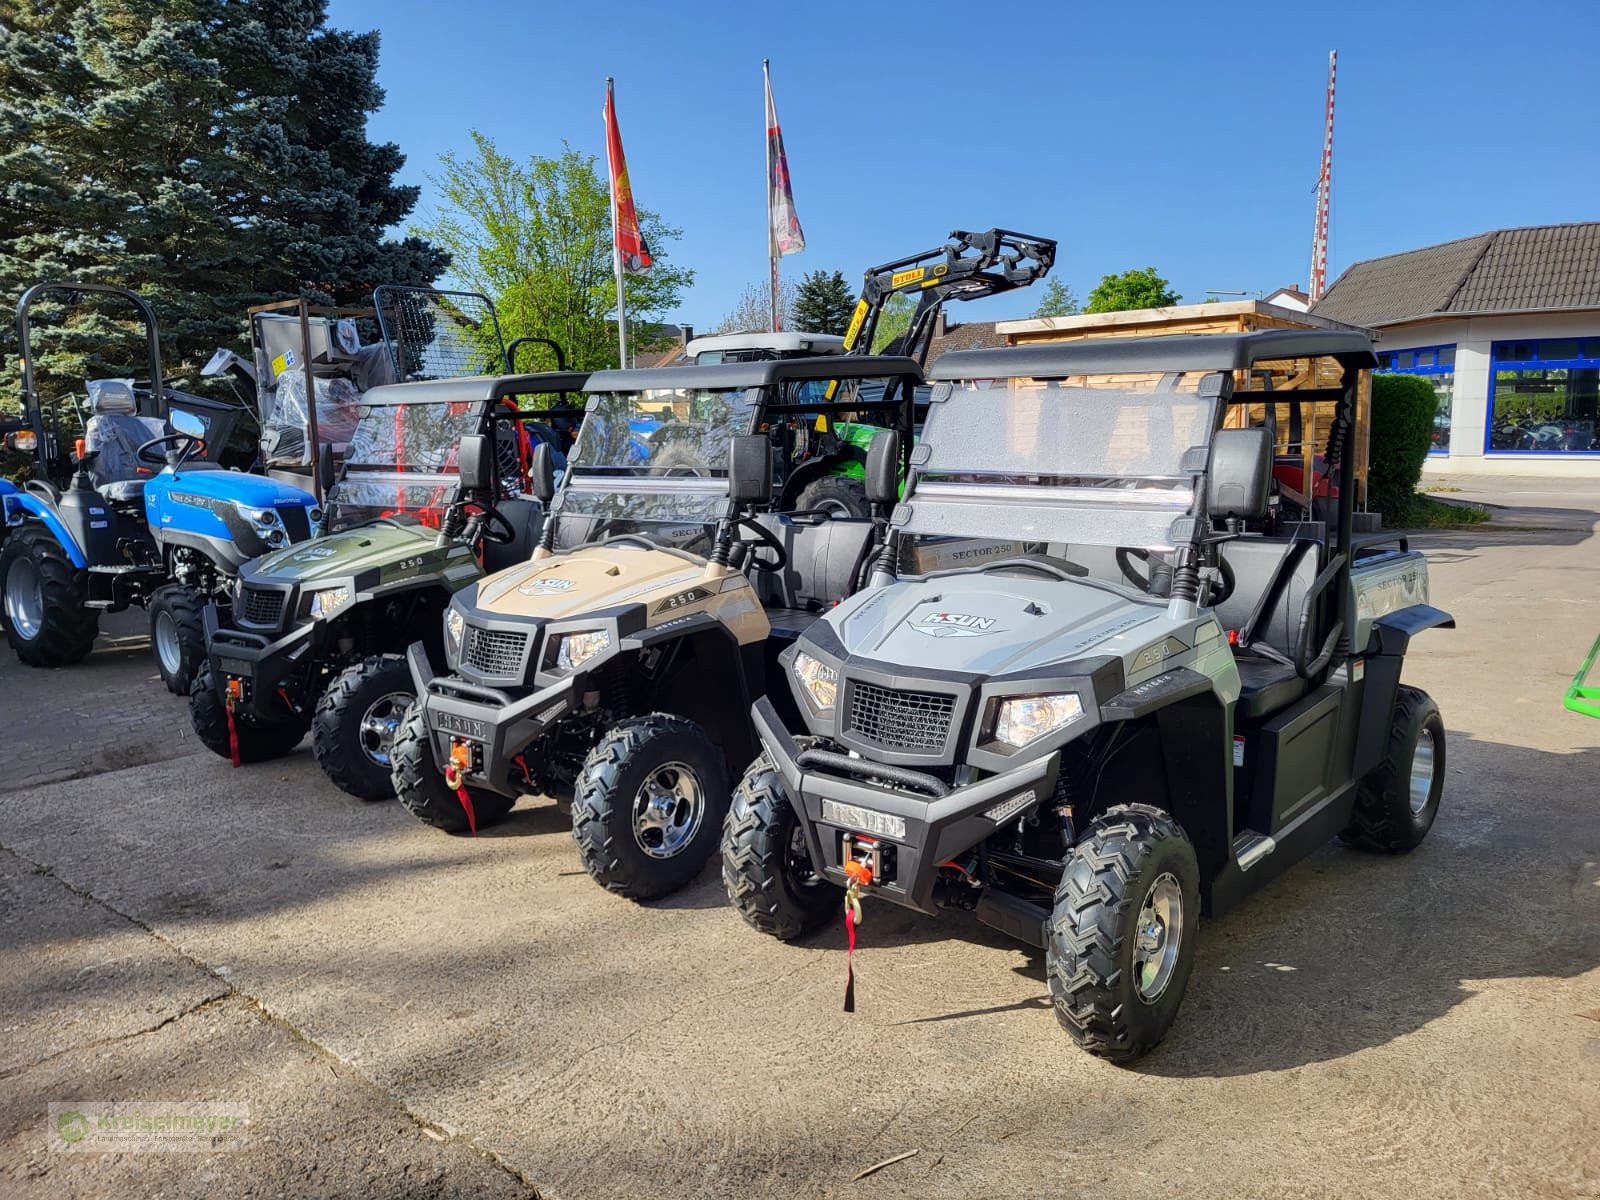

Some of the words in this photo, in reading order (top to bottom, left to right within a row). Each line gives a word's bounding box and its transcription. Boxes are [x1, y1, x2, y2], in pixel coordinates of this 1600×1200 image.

[893, 269, 922, 284] STOLL
[952, 547, 992, 560] SECTOR
[994, 544, 1012, 554] 250
[400, 556, 424, 570] 250
[669, 592, 696, 608] 250
[1143, 643, 1170, 664] 250
